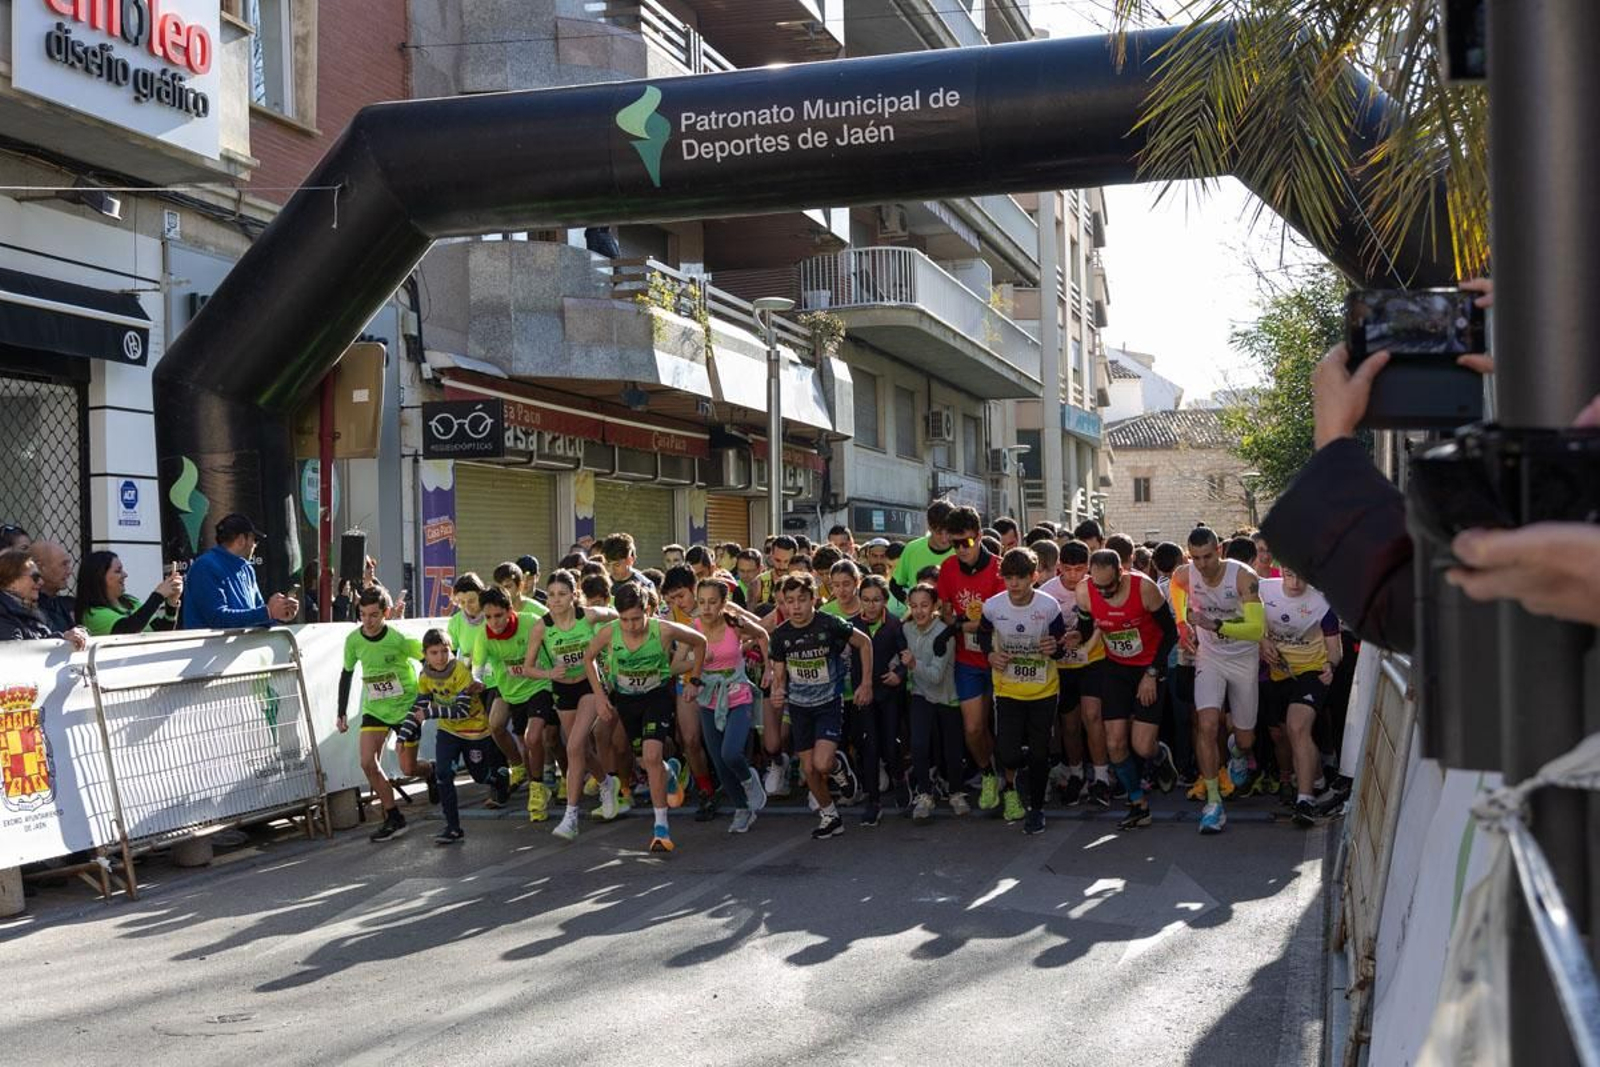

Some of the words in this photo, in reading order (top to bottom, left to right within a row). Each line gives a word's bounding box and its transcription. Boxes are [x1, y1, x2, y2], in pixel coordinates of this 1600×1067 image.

[45, 22, 130, 87] diseño
[132, 67, 209, 118] gráfico
[681, 104, 794, 132] Patronato
[803, 91, 920, 120] Municipal
[929, 87, 961, 108] de
[681, 131, 790, 162] Deportes
[797, 128, 829, 150] de
[836, 120, 895, 147] Jaén
[1112, 640, 1133, 651] 736
[629, 678, 648, 686] 217
[1014, 665, 1037, 677] 808
